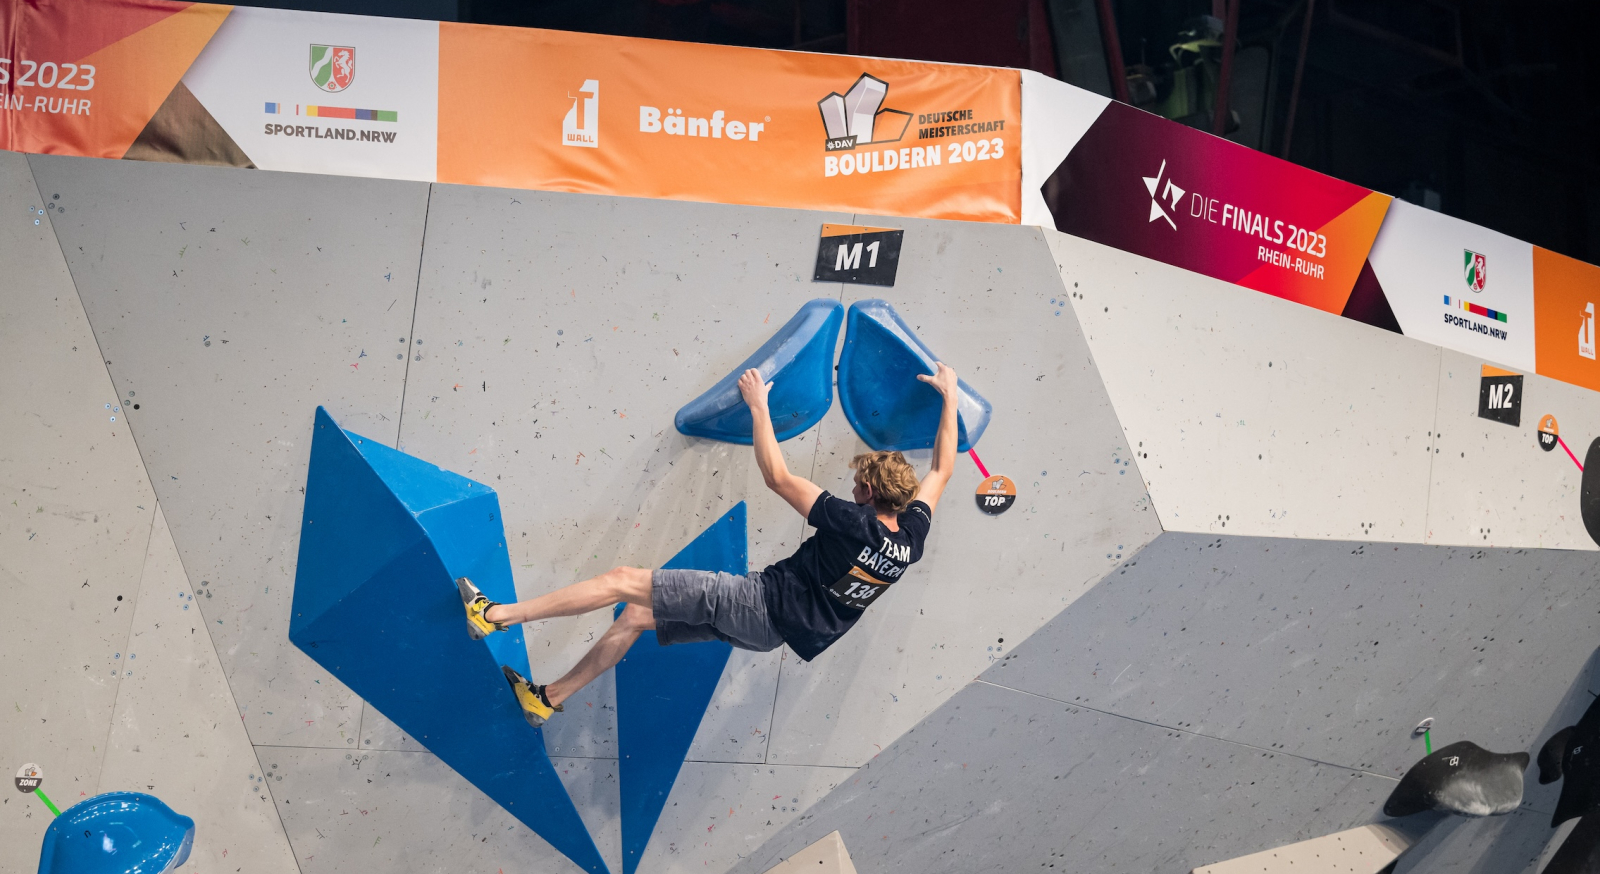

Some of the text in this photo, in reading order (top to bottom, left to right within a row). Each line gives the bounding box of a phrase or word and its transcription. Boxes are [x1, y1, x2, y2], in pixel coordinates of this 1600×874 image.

[16, 60, 96, 91] 2023
[918, 109, 973, 125] DEUTSCHE
[264, 123, 398, 144] SPORTLAND.NRW
[567, 133, 594, 143] WALL
[918, 120, 1006, 140] MEISTERSCHAFT
[835, 139, 854, 149] DAV
[824, 137, 1005, 178] BOULDERN 2023
[1190, 192, 1327, 258] DIE FINALS 2023
[834, 240, 880, 271] M1
[1257, 245, 1325, 280] RHEIN-RUHR
[1444, 313, 1508, 341] SPORTLAND.NRW
[1488, 383, 1514, 410] M2
[1541, 433, 1554, 445] TOP
[984, 495, 1006, 507] TOP
[879, 536, 911, 563] TEAM
[843, 581, 880, 600] 136
[19, 778, 38, 787] ZONE
